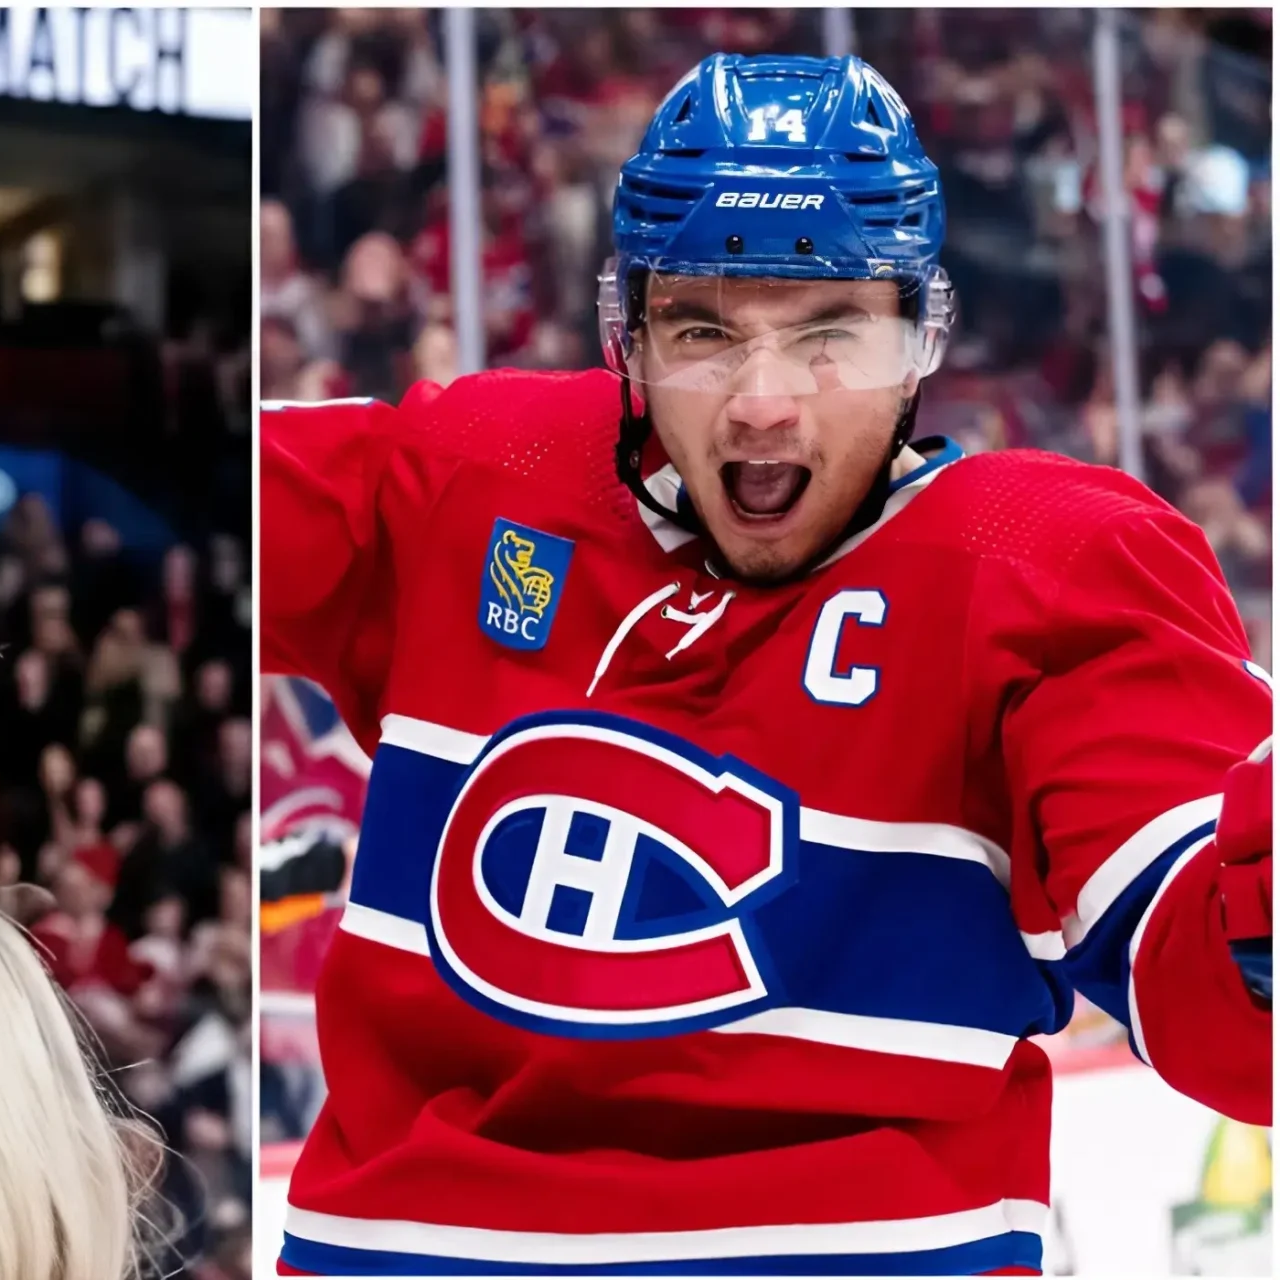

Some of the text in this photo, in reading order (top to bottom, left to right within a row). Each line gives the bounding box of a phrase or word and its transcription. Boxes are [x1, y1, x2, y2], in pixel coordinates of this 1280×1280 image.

[747, 107, 808, 143] 14
[486, 600, 540, 642] RBC
[802, 588, 888, 706] C
